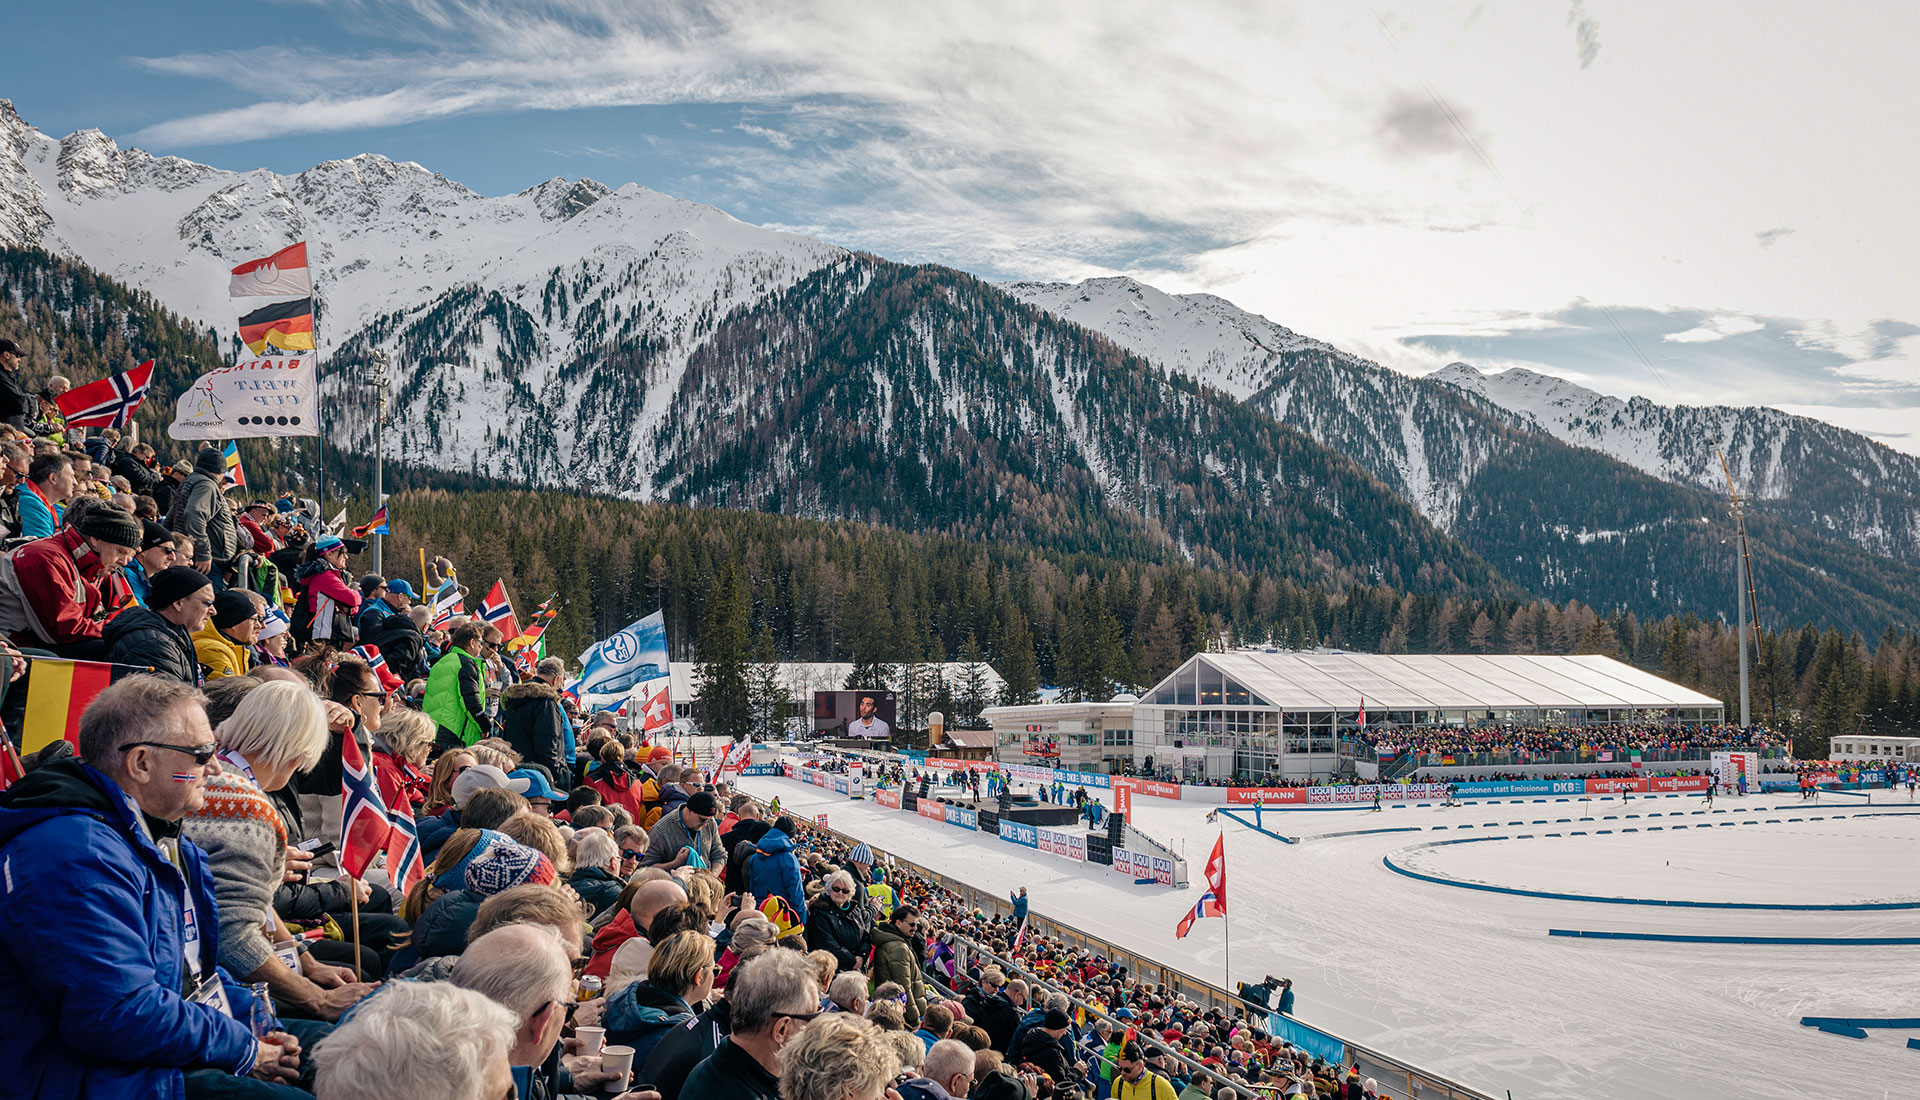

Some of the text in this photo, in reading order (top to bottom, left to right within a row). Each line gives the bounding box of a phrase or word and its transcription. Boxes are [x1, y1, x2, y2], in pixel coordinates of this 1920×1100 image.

[1457, 785, 1492, 793] motionen
[1553, 782, 1575, 792] DKB
[1658, 778, 1700, 790] VIESSMANN
[1239, 790, 1295, 802] VIESSMANN
[1310, 787, 1330, 795] LIQUI
[1336, 793, 1355, 801] MOLY
[1384, 792, 1402, 800] MOLY
[1407, 791, 1425, 799] MOLY
[1000, 823, 1031, 844] DKB DKB
[1054, 833, 1066, 845] LIQUI
[1069, 836, 1082, 848] LIQUI
[1054, 843, 1066, 855] MOLY
[1069, 847, 1082, 859] MOLY
[1114, 848, 1130, 862] LIQUI
[1114, 860, 1130, 873] MOLY
[1134, 853, 1149, 868] LIQUI
[1154, 858, 1171, 872] LIQUI
[1134, 865, 1149, 878] MOLY
[1154, 870, 1171, 884] MOLY
